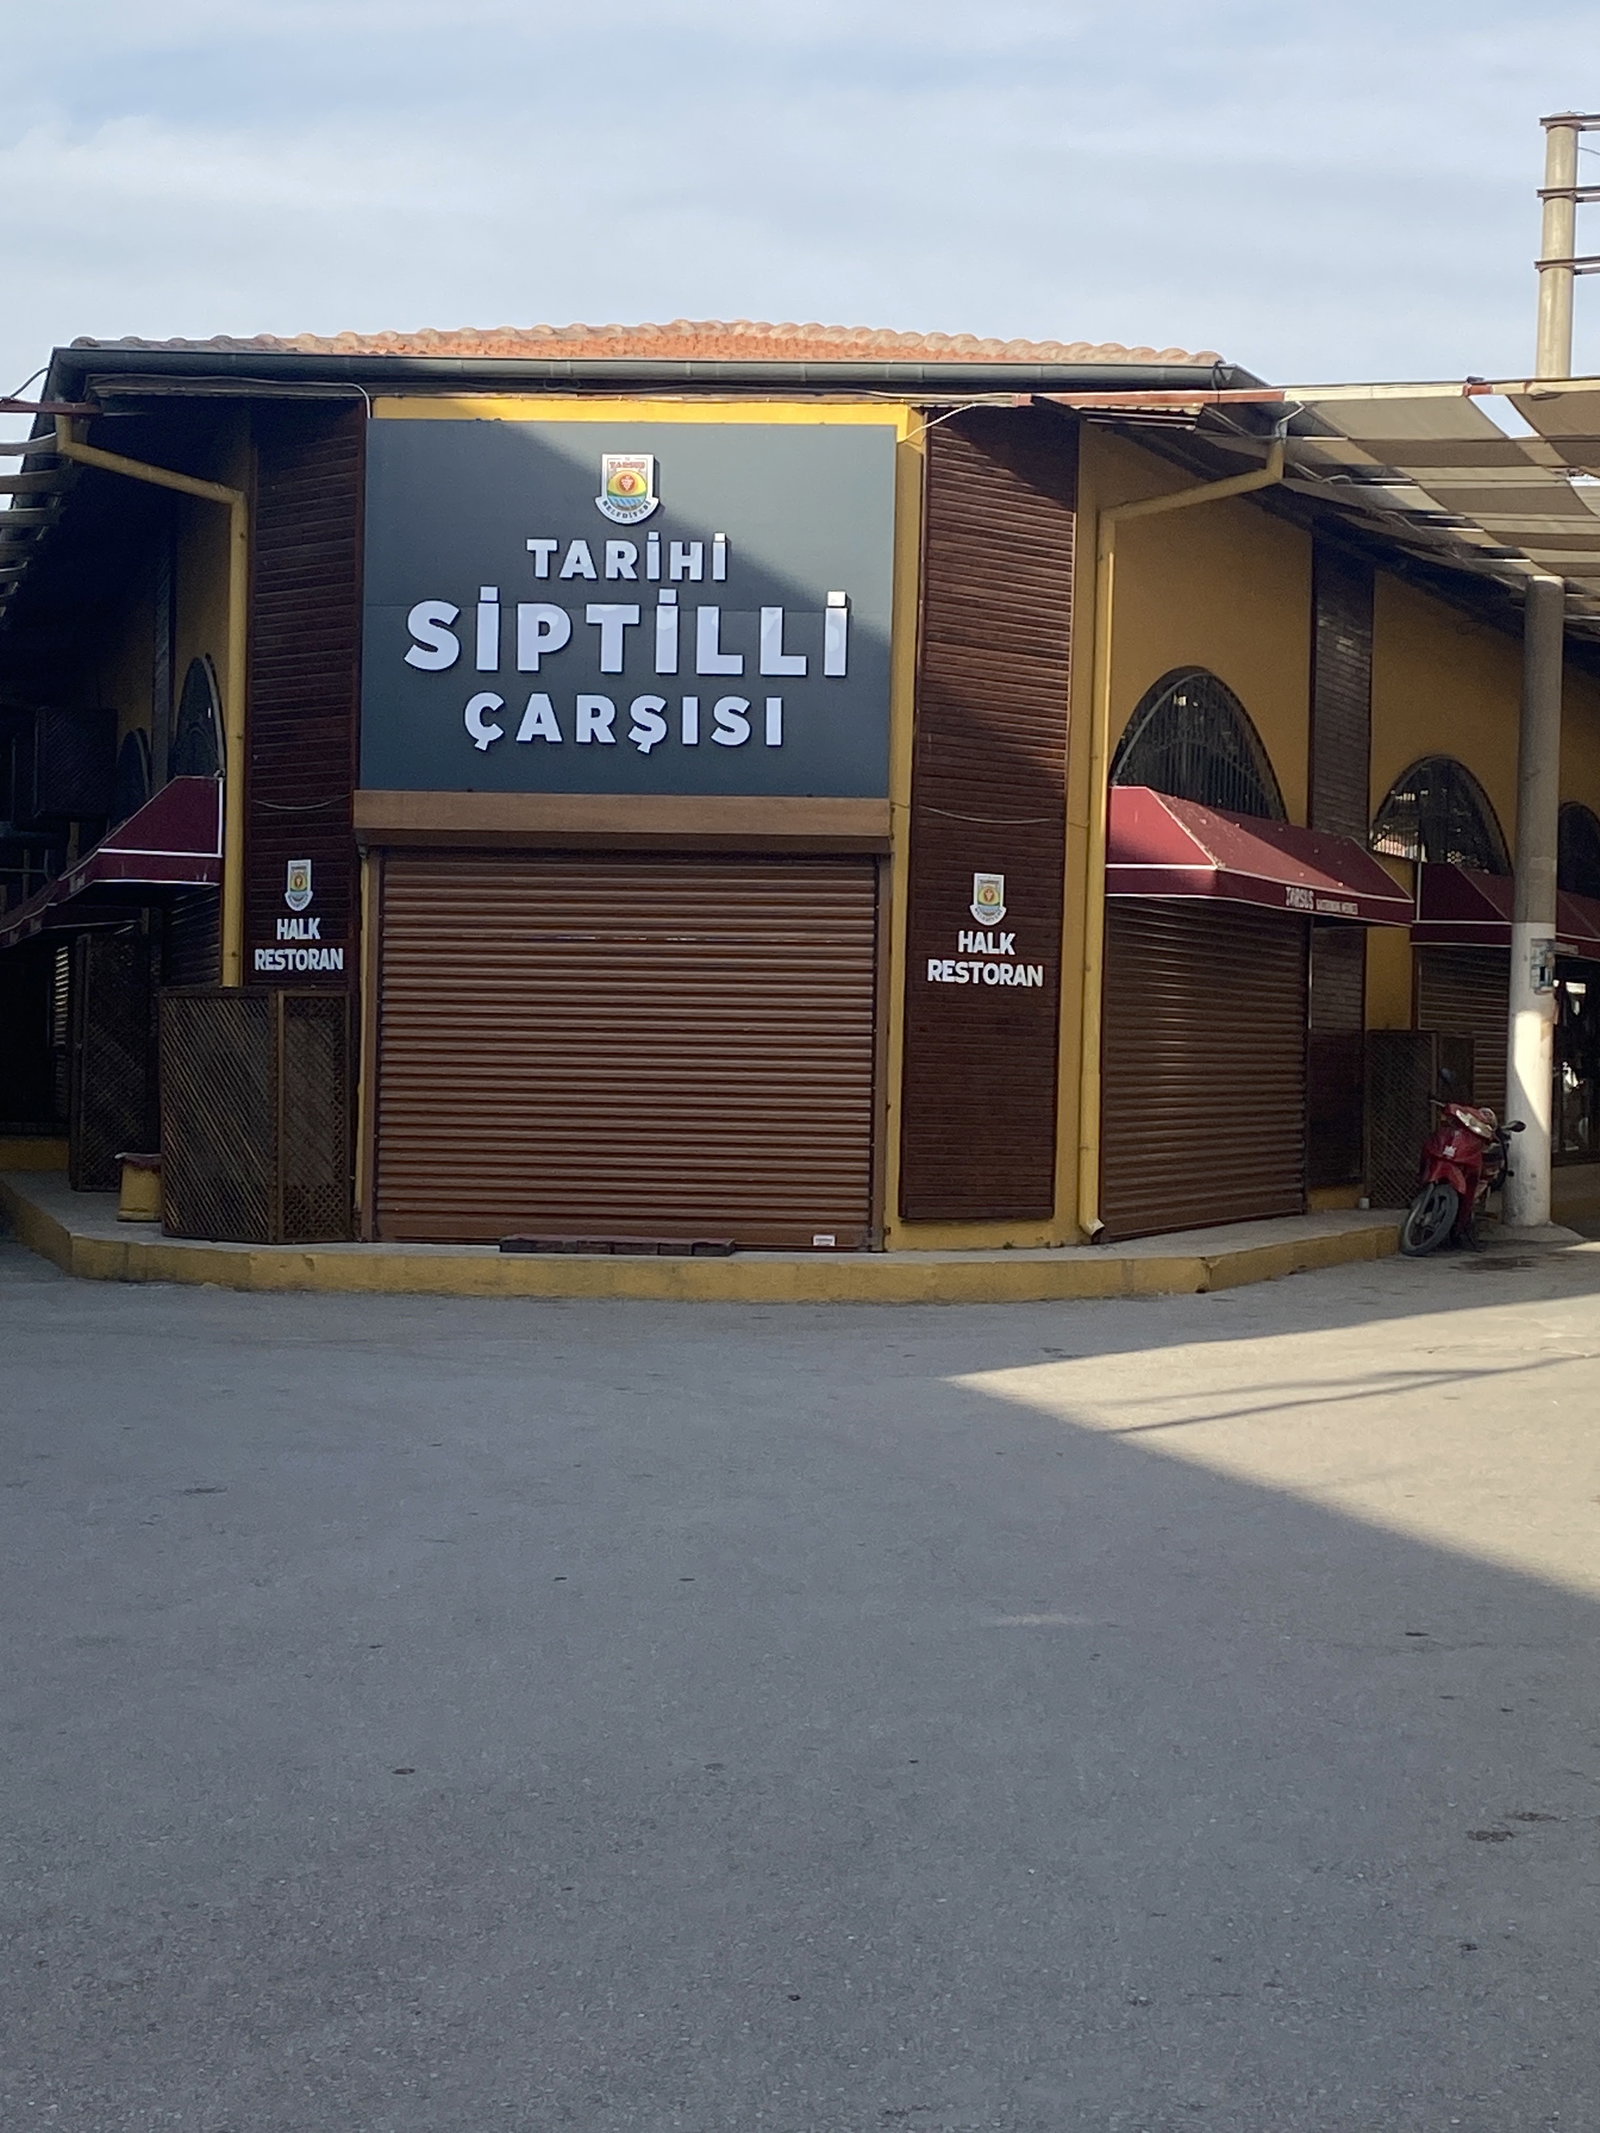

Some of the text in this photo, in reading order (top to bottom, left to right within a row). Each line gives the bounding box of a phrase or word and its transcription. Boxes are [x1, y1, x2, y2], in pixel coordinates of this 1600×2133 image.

[527, 531, 726, 581] TARİHİ
[403, 586, 848, 677] SİPTİLLİ
[463, 692, 782, 754] ÇARŞISI
[277, 918, 321, 940] HALK
[958, 930, 1016, 955] HALK
[254, 948, 344, 971] RESTORAN
[927, 959, 1044, 987] RESTORAN
